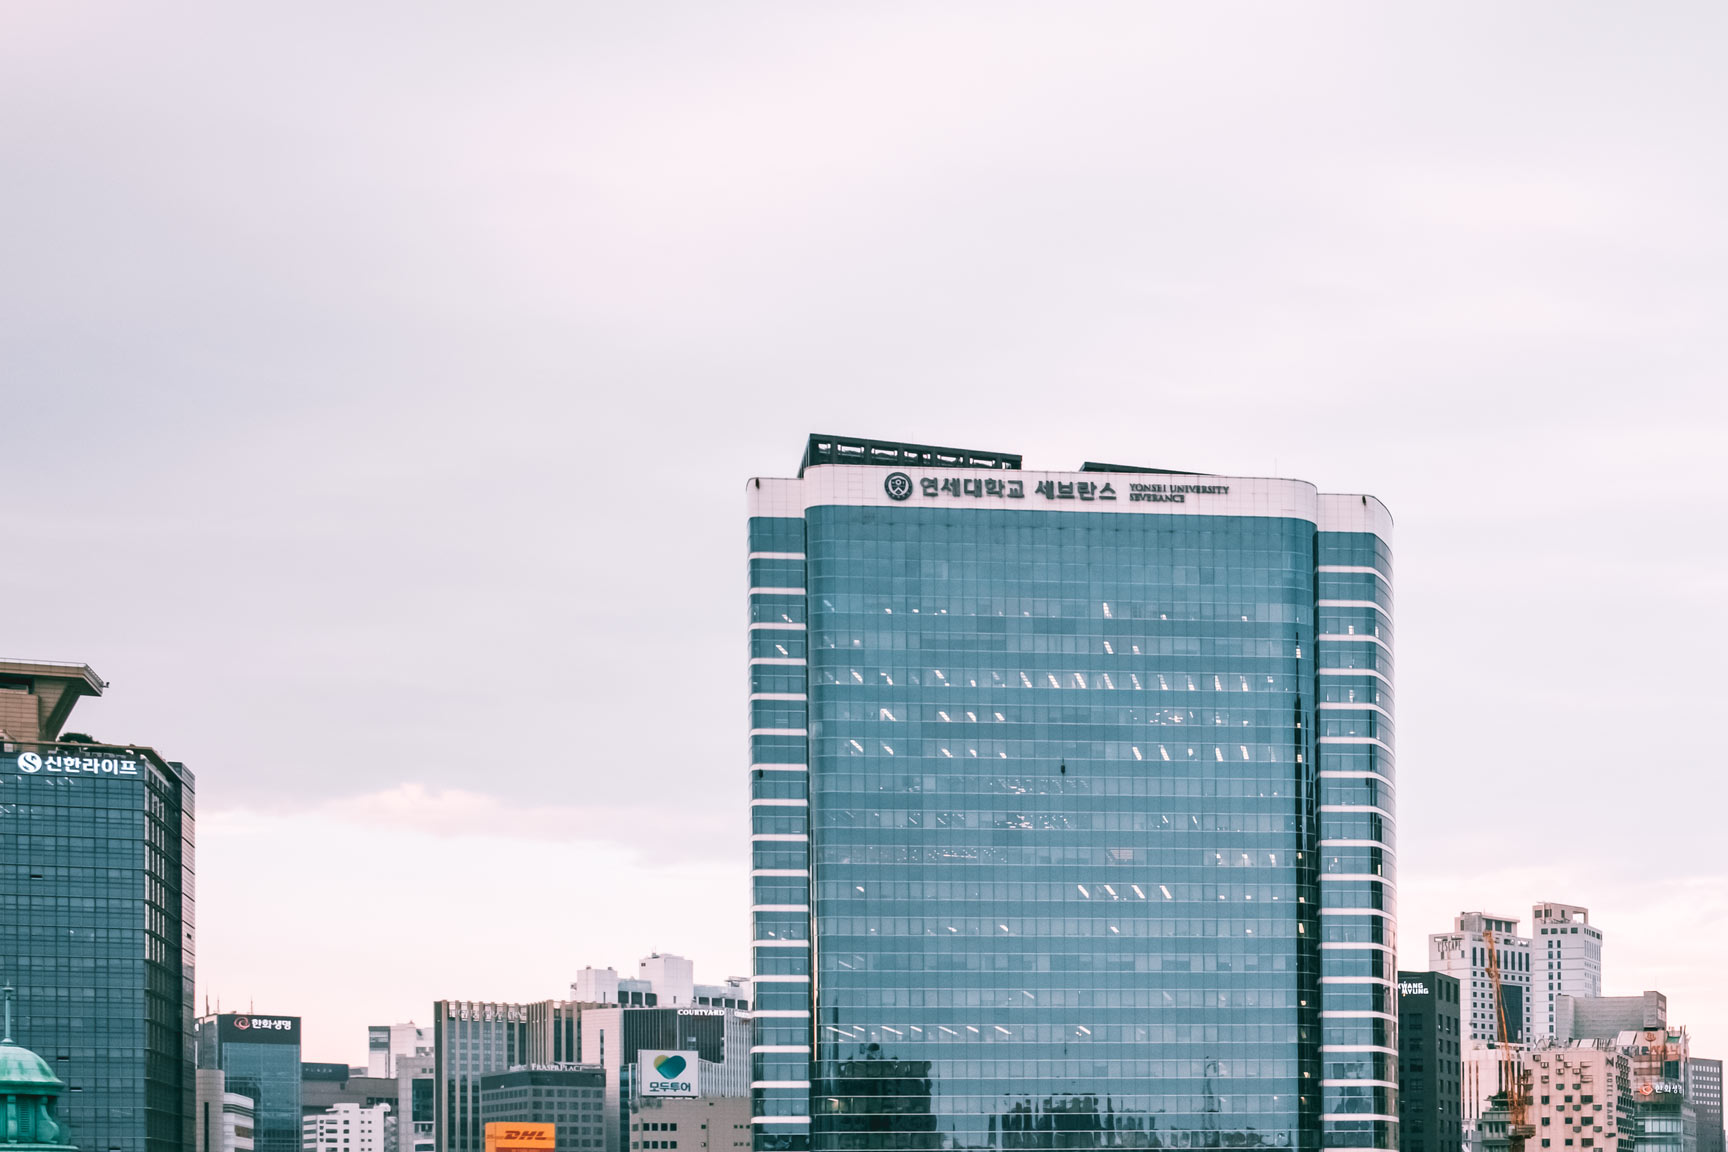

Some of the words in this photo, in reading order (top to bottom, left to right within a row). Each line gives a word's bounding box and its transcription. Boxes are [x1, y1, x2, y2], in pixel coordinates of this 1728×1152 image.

[920, 477, 1025, 498] 연세대학교
[1034, 480, 1117, 501] 세브란스
[1129, 483, 1167, 492] YONSEI
[1170, 484, 1230, 495] UNIVERSITY
[1129, 493, 1185, 503] SEVERANCE
[44, 756, 138, 775] 신한라이프
[678, 1009, 725, 1017] COURTYARD
[251, 1018, 292, 1031] 한화생명
[649, 1081, 691, 1092] 모두투어
[504, 1130, 547, 1140] DHL
